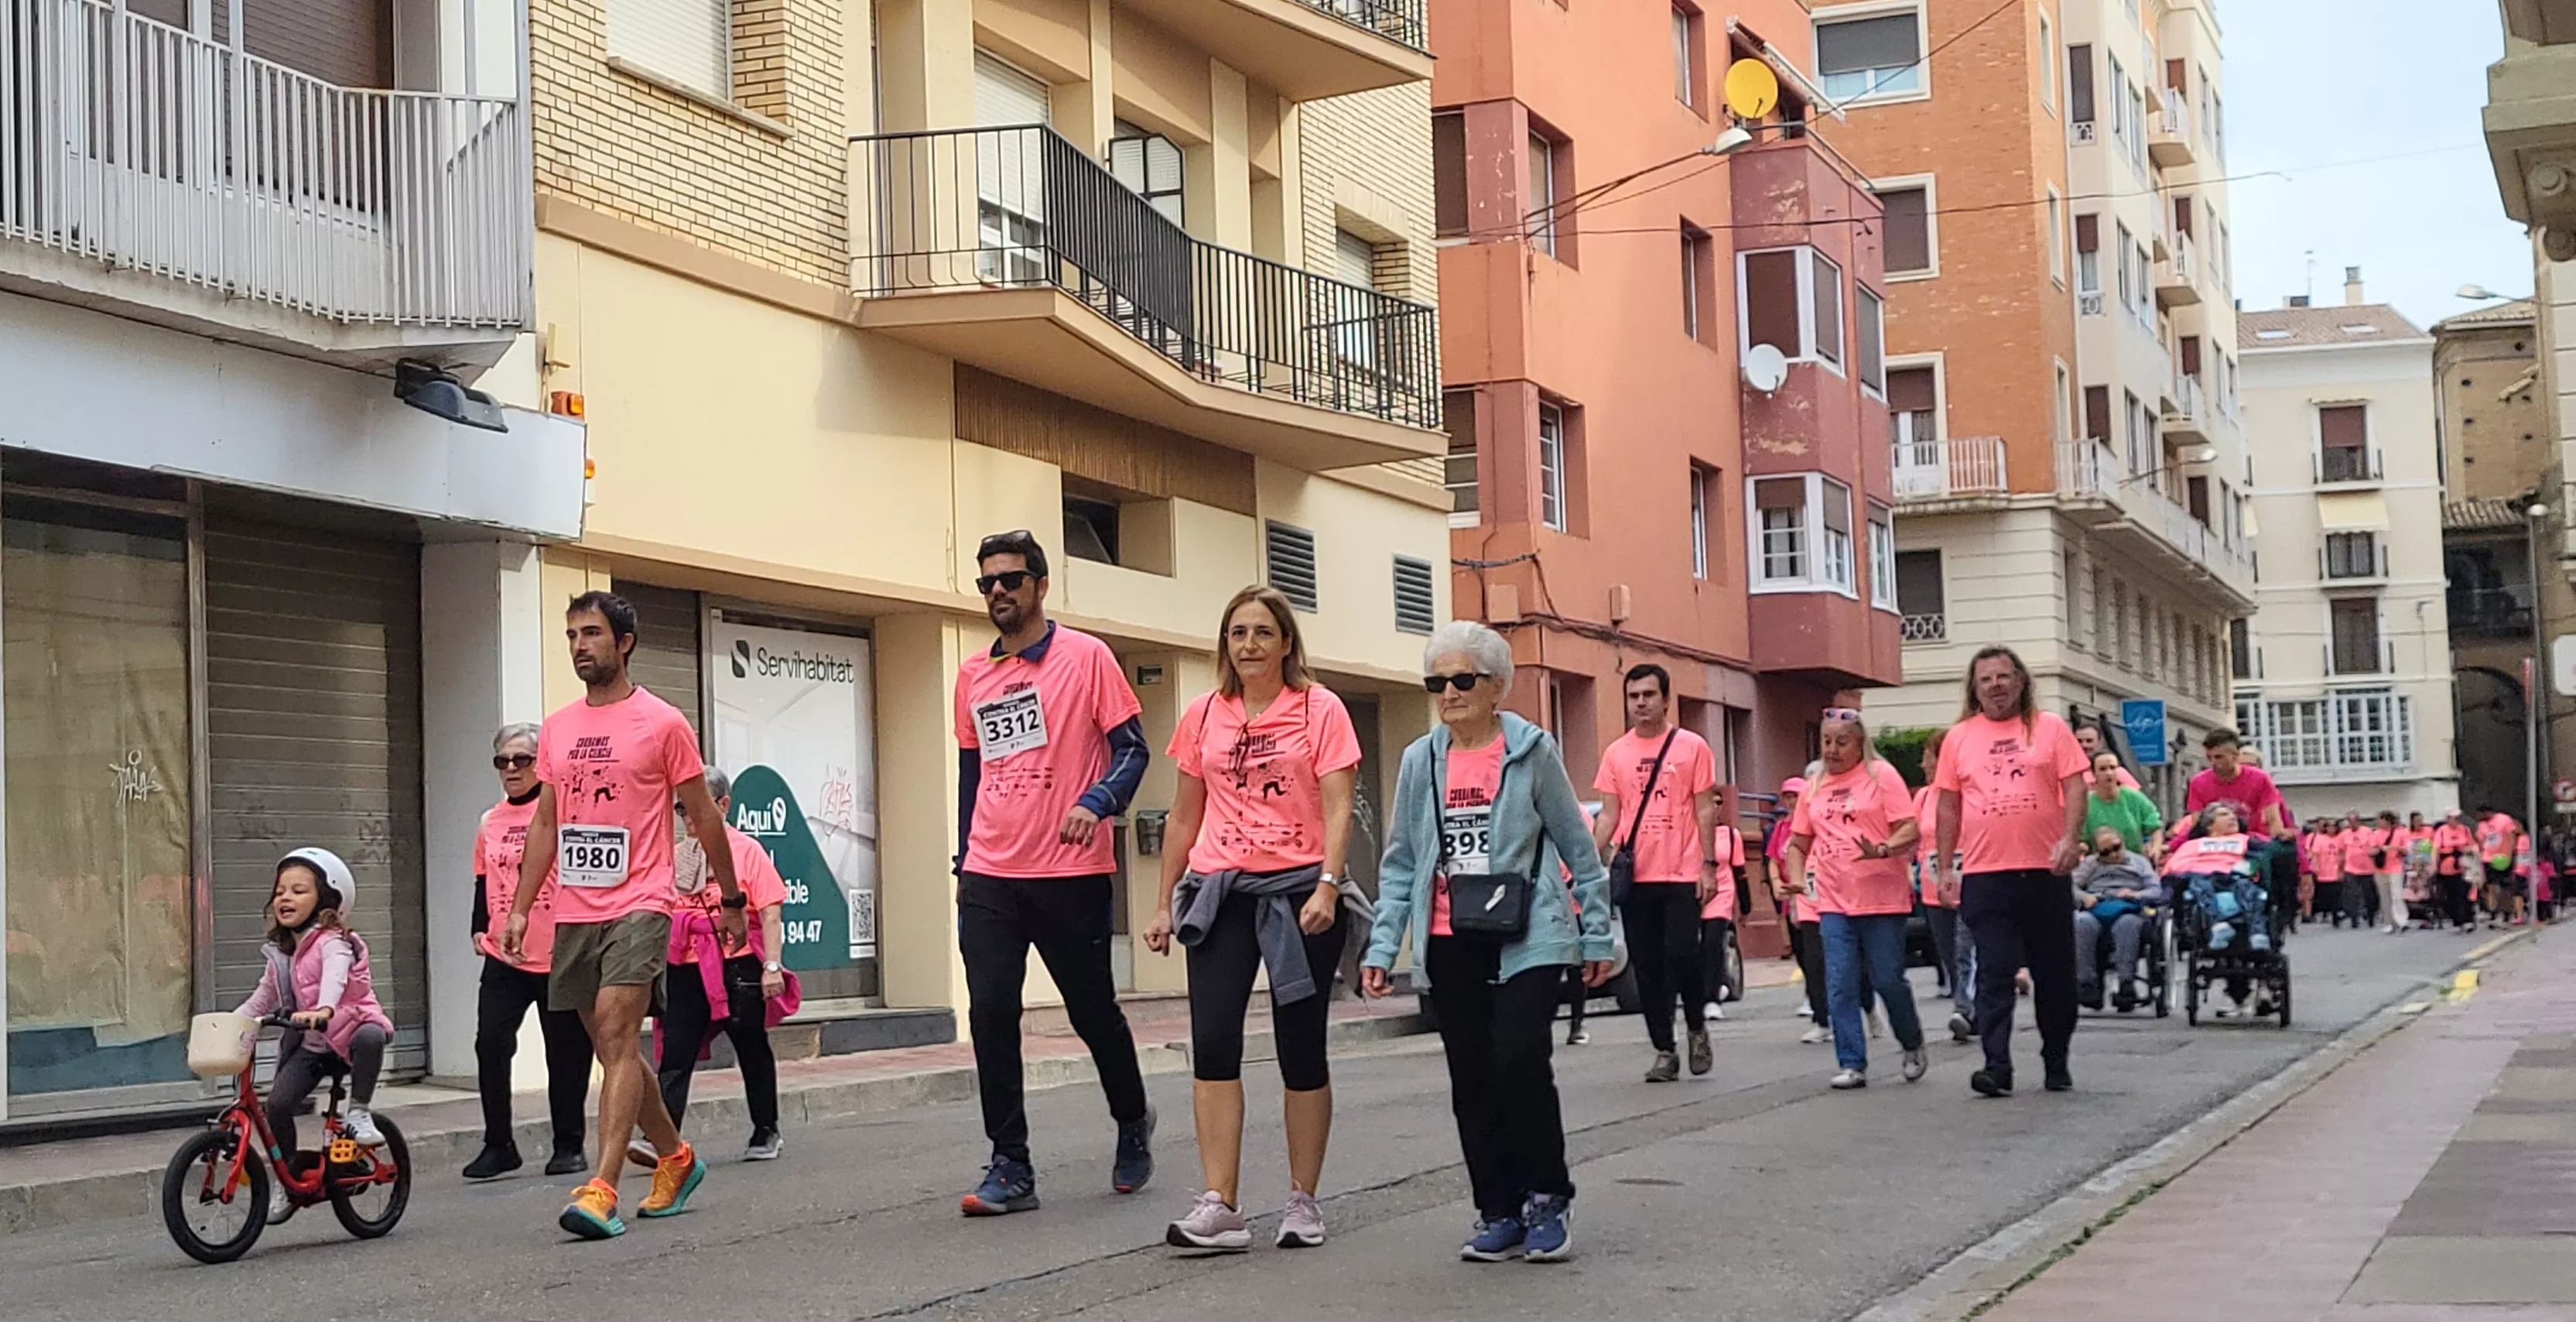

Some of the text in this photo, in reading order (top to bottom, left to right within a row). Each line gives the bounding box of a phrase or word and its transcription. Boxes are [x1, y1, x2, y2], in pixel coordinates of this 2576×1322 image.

[758, 647, 854, 683] Servihabitat
[986, 710, 1040, 741] 3312
[737, 803, 771, 837] Aquí
[565, 845, 620, 869] 1980
[788, 920, 805, 944] 94
[806, 920, 822, 943] 47
